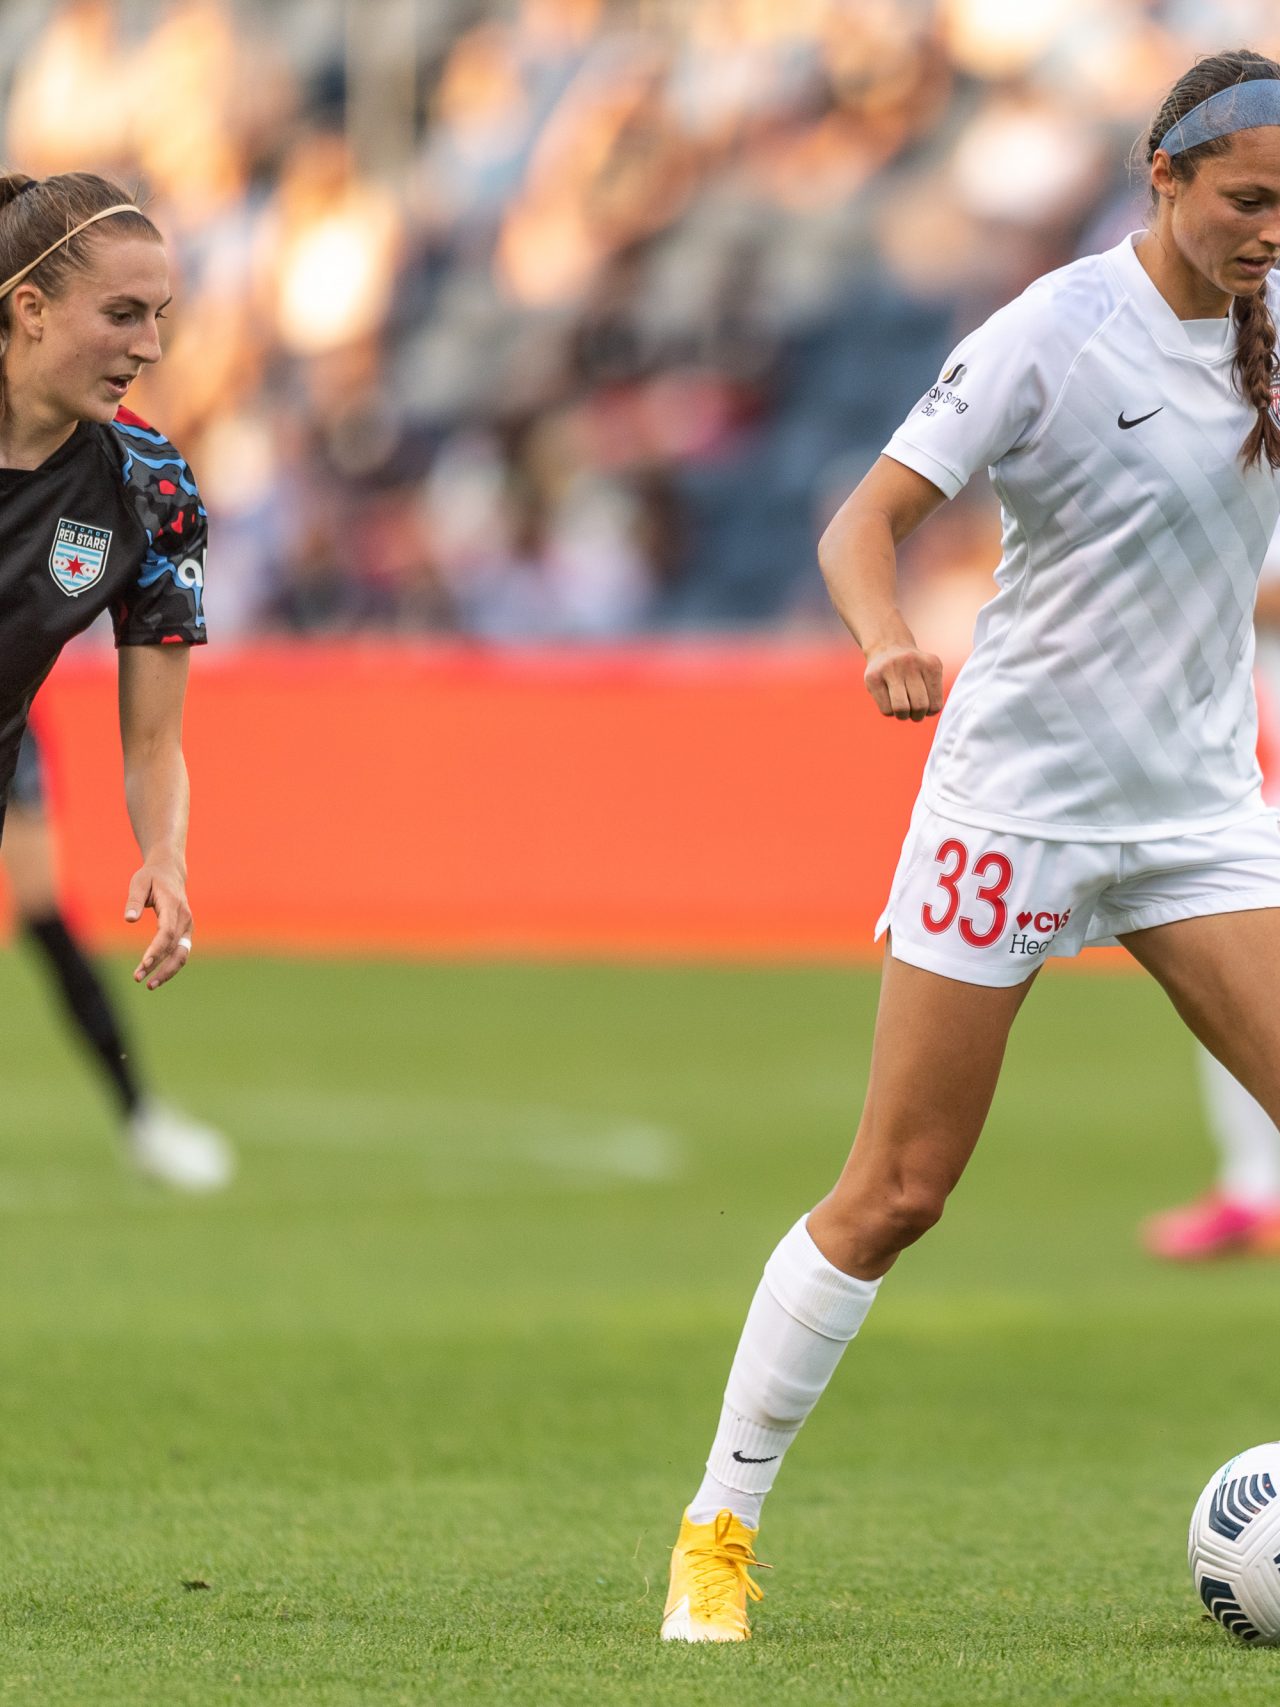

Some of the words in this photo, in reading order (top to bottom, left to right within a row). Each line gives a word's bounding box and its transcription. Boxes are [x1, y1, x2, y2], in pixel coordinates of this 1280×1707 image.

[58, 528, 75, 543] RED
[76, 533, 106, 551] STARS
[921, 838, 1013, 949] 33
